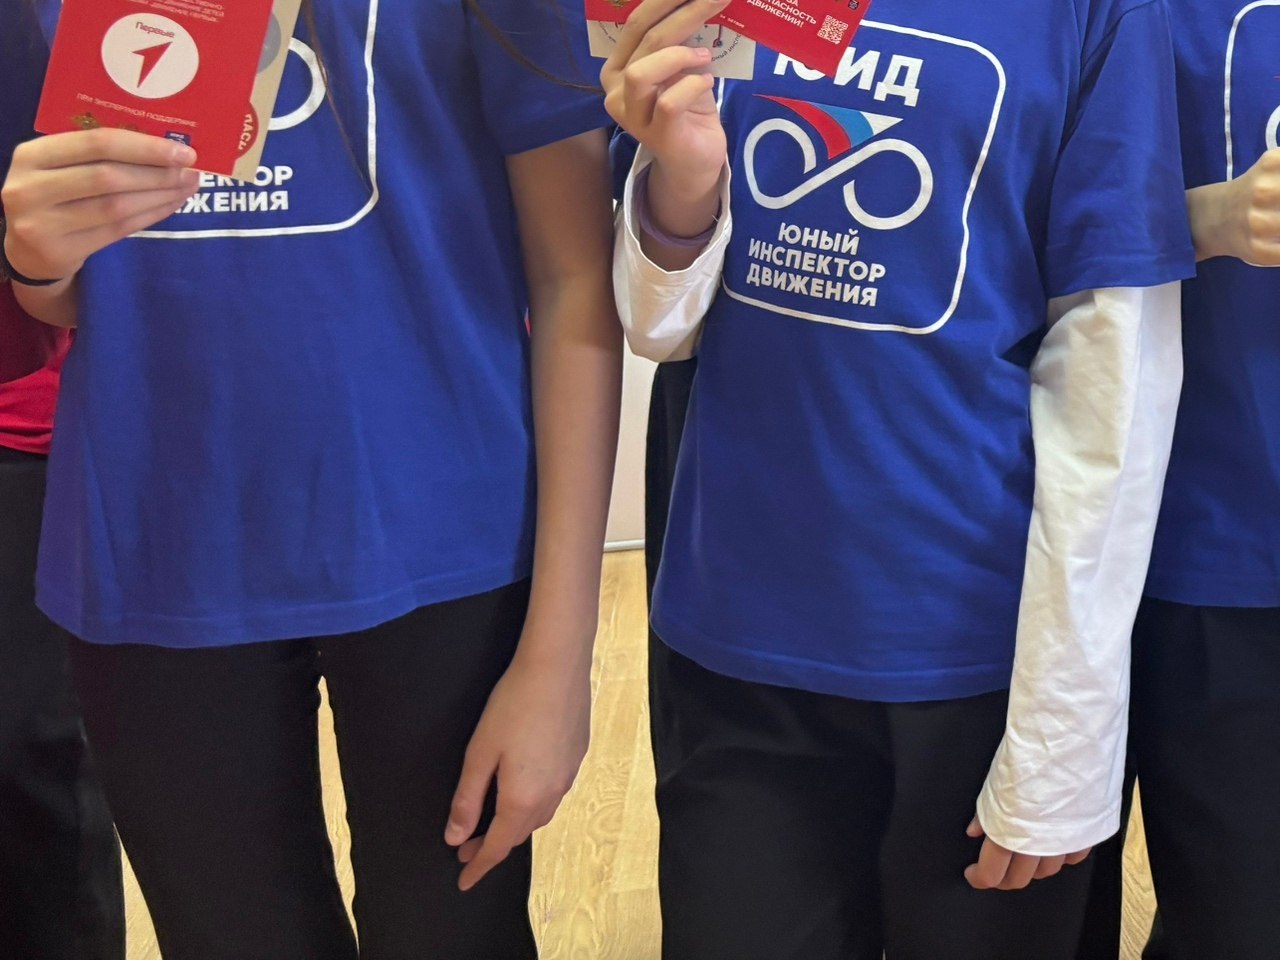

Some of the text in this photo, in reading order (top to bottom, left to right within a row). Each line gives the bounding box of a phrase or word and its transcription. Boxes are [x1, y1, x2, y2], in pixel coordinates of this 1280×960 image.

[176, 191, 289, 216] ЖЕНИЯ
[778, 222, 860, 256] ЮНЫЙ
[748, 238, 886, 283] ИНСПЕКТОР
[746, 263, 878, 307] ДВИЖЕНИЯ
